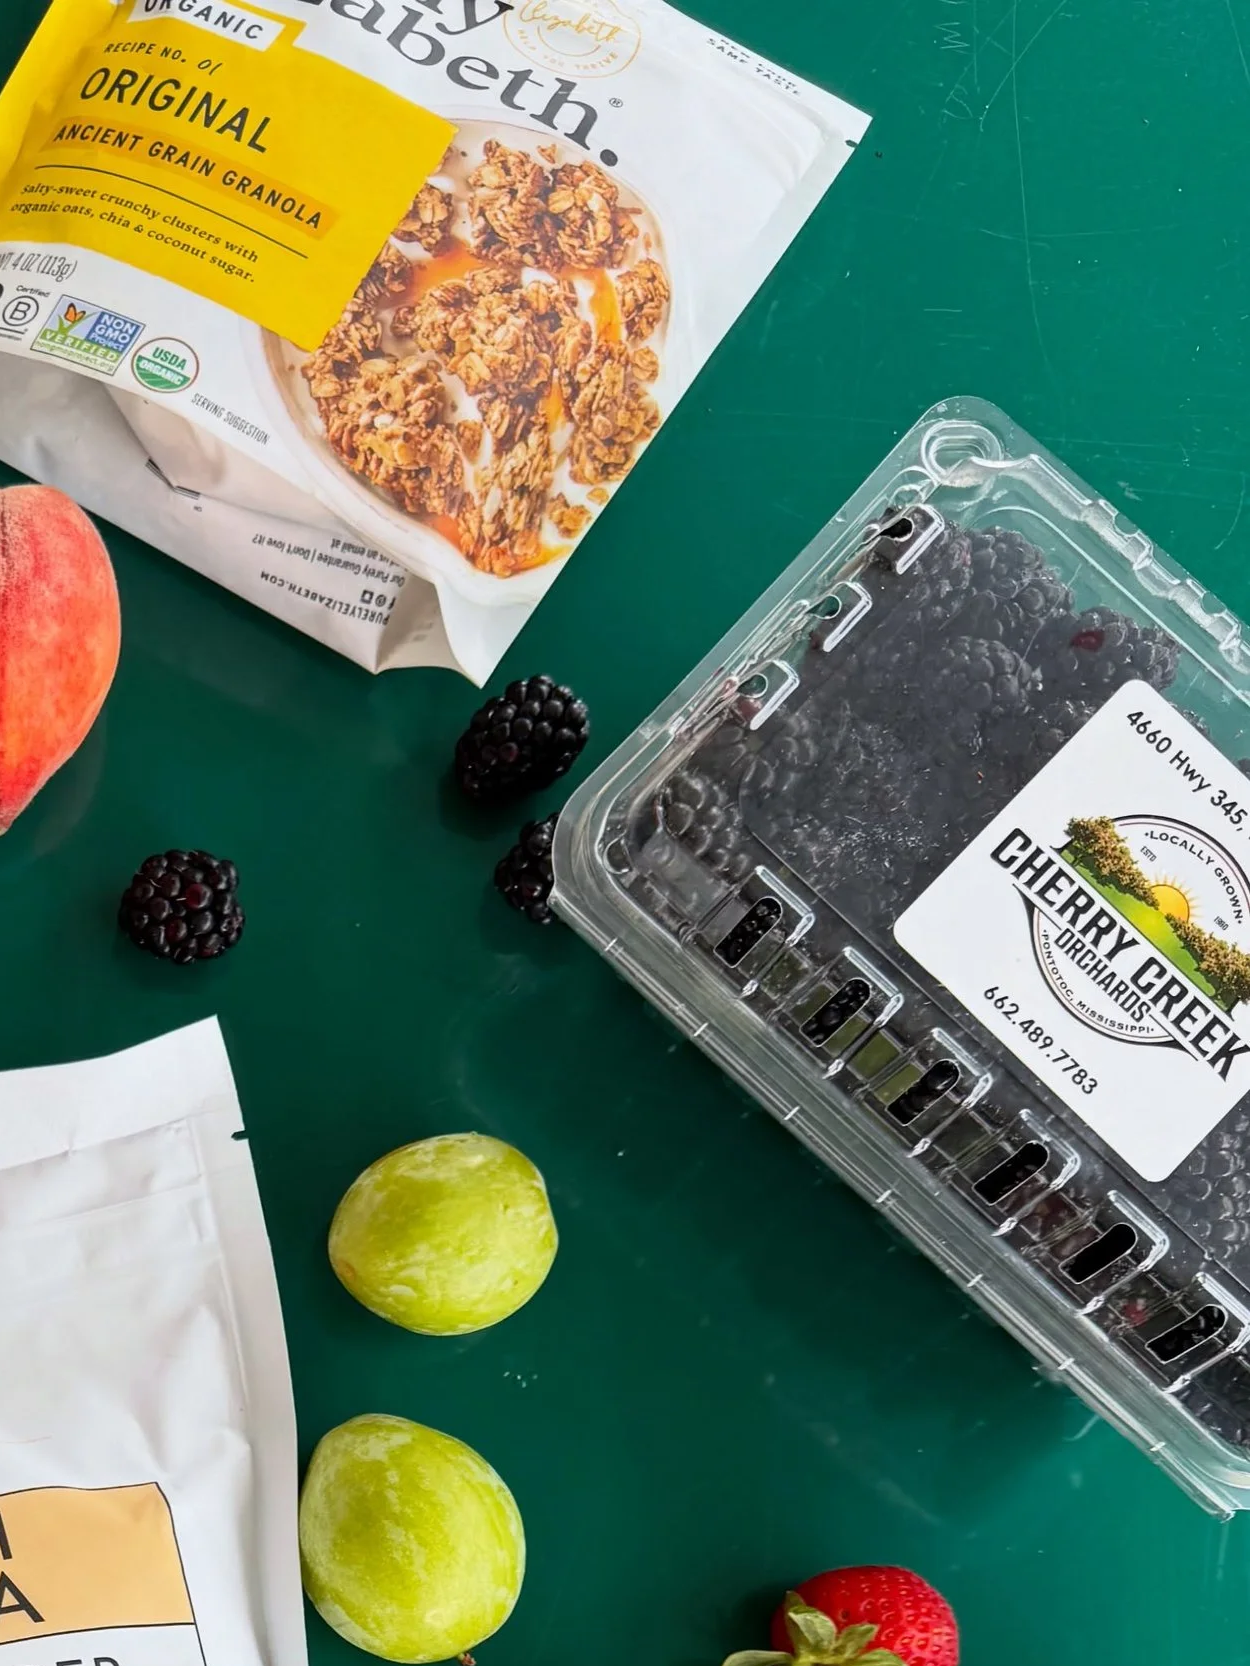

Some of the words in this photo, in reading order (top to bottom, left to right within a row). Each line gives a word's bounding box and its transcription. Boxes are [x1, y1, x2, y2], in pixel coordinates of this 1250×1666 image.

[104, 41, 156, 56] RECIPE
[160, 46, 187, 63] NO.
[80, 67, 272, 153] ORIGINAL
[53, 124, 143, 152] ANCIENT
[147, 141, 216, 177] GRAIN
[221, 170, 322, 230] GRANOLA
[21, 183, 98, 199] salty-sweet
[100, 192, 160, 220] crunchy
[162, 212, 222, 245] clusters
[225, 239, 259, 264] with
[10, 201, 60, 215] organic
[62, 204, 95, 219] oats,
[99, 210, 131, 229] chia
[133, 223, 144, 234] &
[147, 229, 207, 260] coconut
[209, 255, 255, 283] sugar.
[12, 252, 23, 270] 4
[21, 252, 39, 272] OZ
[36, 254, 78, 283] (113g)
[16, 284, 51, 298] Certified
[9, 301, 32, 321] B
[99, 313, 138, 334] NON
[45, 330, 119, 362] VERIFIED
[94, 323, 133, 345] GMO
[138, 358, 184, 386] ORGANIC
[152, 346, 187, 371] USDA
[191, 393, 223, 419] SERVING
[223, 411, 271, 446] SUGGESTION
[252, 532, 266, 545] it?
[265, 535, 287, 552] love
[286, 541, 311, 562] Don't
[341, 541, 366, 557] email
[317, 551, 361, 575] Guarantee
[362, 564, 390, 584] Purely
[260, 570, 391, 626] PURELYELIZABETH.COM
[1126, 711, 1173, 755] 4660
[1169, 750, 1212, 794] Hwy
[1210, 790, 1249, 833] 345,
[1140, 845, 1157, 862] ESTD
[1149, 830, 1215, 865] LOCALLY
[1214, 867, 1243, 920] GROWN
[990, 827, 1140, 963] CHERRY
[1129, 956, 1250, 1083] CREEK
[1041, 933, 1075, 1003] PONTOTOC,
[1076, 1000, 1152, 1034] MISSISSIPPI
[1054, 928, 1152, 1023] ORCHARDS
[983, 986, 1099, 1095] 662.489.7783
